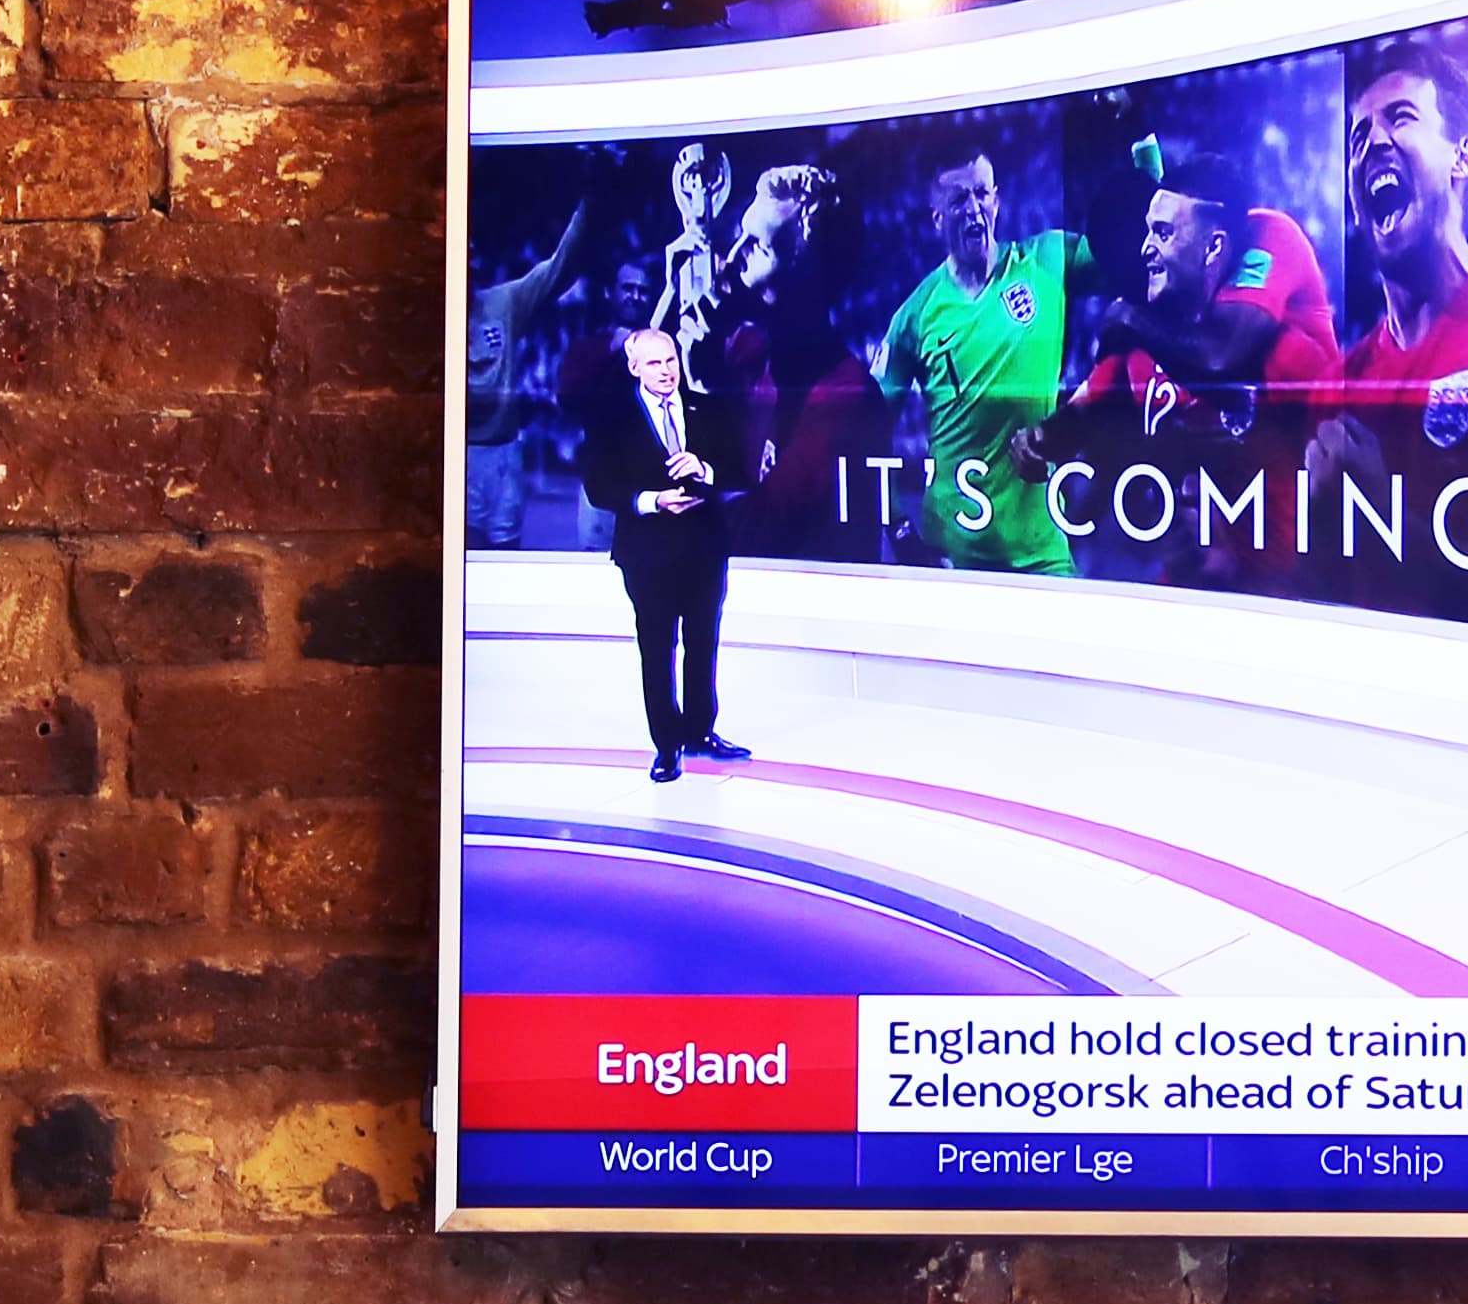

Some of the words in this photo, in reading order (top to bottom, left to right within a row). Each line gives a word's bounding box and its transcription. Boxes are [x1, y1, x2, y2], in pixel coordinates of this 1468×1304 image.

[836, 455, 994, 532] IT'S
[888, 1020, 1055, 1065] England
[1069, 1020, 1163, 1057] hold
[1173, 1021, 1313, 1059] closed
[596, 1041, 788, 1095] England
[887, 1073, 1149, 1118] Zelenogorsk
[1163, 1074, 1295, 1110] ahead
[1308, 1074, 1353, 1111] of
[599, 1140, 697, 1174] World
[706, 1141, 774, 1179] Cup
[936, 1142, 1065, 1175] Premier
[1073, 1144, 1134, 1182] Lge
[1319, 1145, 1445, 1182] Ch'ship
